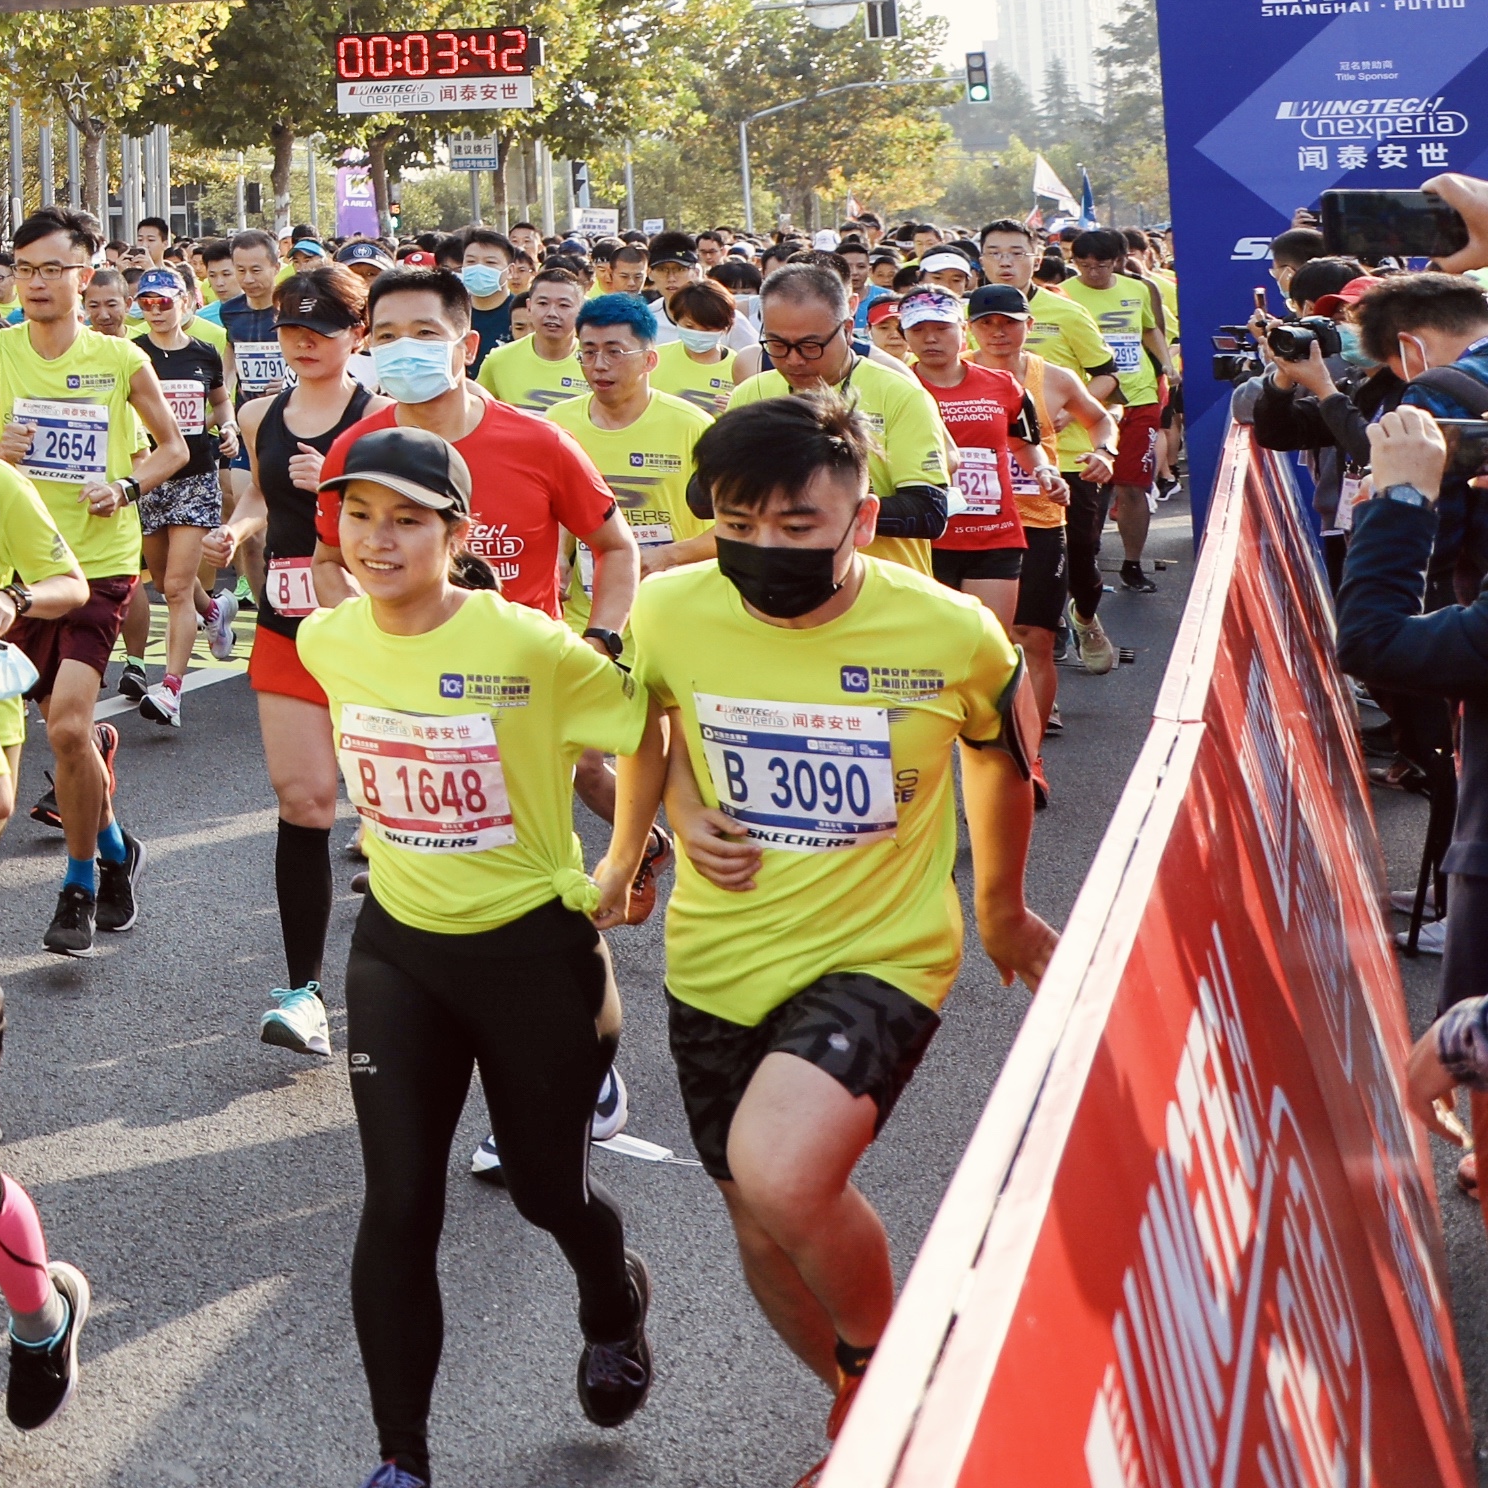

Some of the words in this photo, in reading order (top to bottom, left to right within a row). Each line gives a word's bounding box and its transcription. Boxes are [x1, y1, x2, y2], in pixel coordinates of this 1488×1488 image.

[1261, 2, 1370, 17] SHANGHAI
[338, 30, 527, 78] 00:03:42
[1358, 72, 1398, 81] Sponsor
[348, 84, 424, 95] WINGTECH
[440, 83, 518, 102] 闻泰安世
[367, 92, 428, 106] nexperia
[1276, 97, 1444, 119] WINGTECH
[1318, 112, 1454, 141] nexperia
[1298, 143, 1448, 171] 闻泰安世
[242, 361, 250, 377] B
[255, 361, 284, 377] 2791
[173, 401, 196, 419] 202
[943, 414, 993, 422] МАРАФОН
[46, 431, 96, 461] 2654
[29, 469, 85, 480] SKECHERS
[279, 573, 290, 603] B
[731, 713, 784, 726] nexperia
[793, 713, 862, 731] 闻泰安世
[412, 725, 472, 740] 闻泰安世
[359, 758, 381, 807] B
[396, 765, 487, 815] 1648
[723, 750, 748, 803] B
[768, 757, 870, 816] 3090
[385, 830, 478, 848] SKECHERS
[746, 829, 858, 848] SKECHERS
